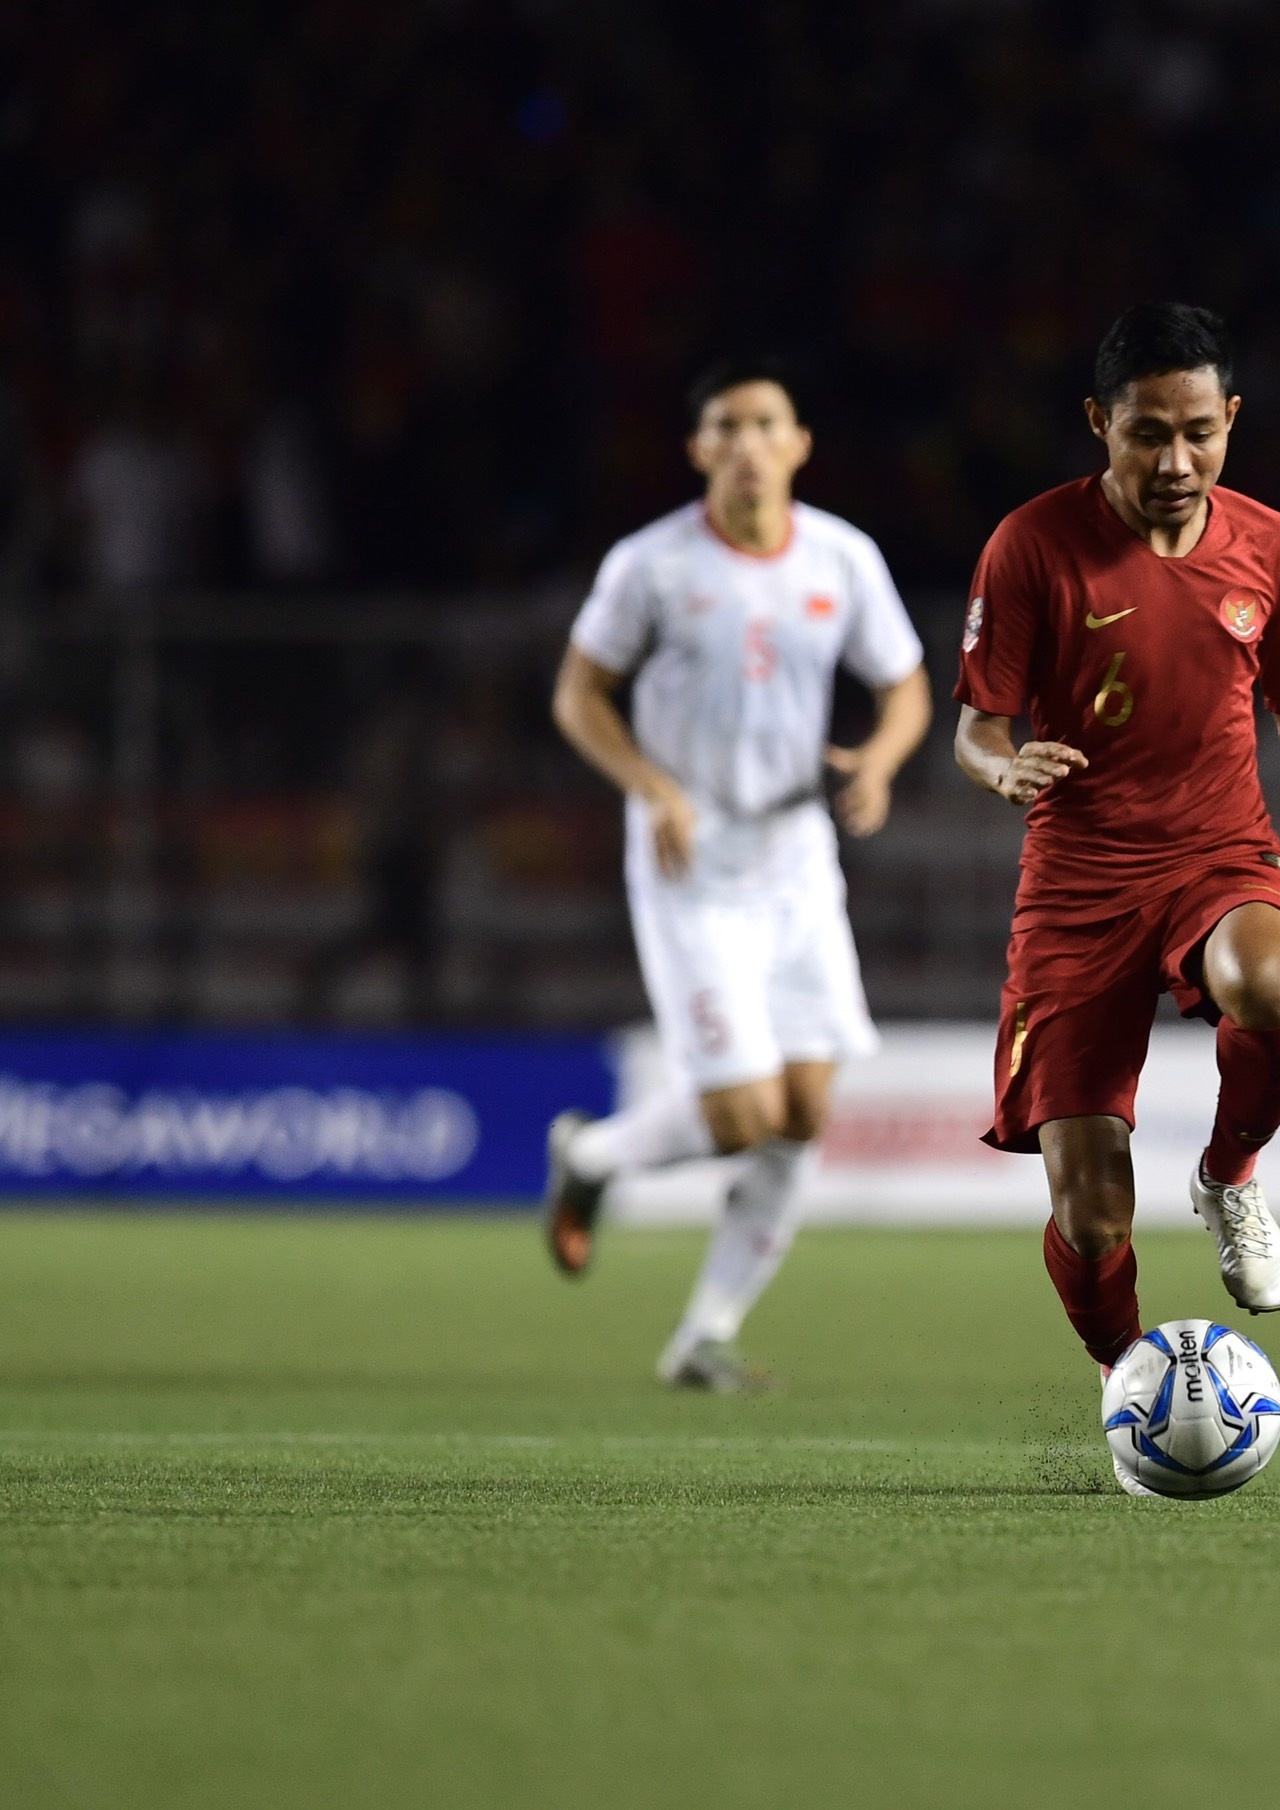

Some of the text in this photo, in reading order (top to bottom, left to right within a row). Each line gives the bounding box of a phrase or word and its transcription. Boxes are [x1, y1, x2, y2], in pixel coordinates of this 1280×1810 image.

[745, 616, 780, 682] 5
[1094, 651, 1134, 727] 6
[1179, 1330, 1205, 1402] molten
